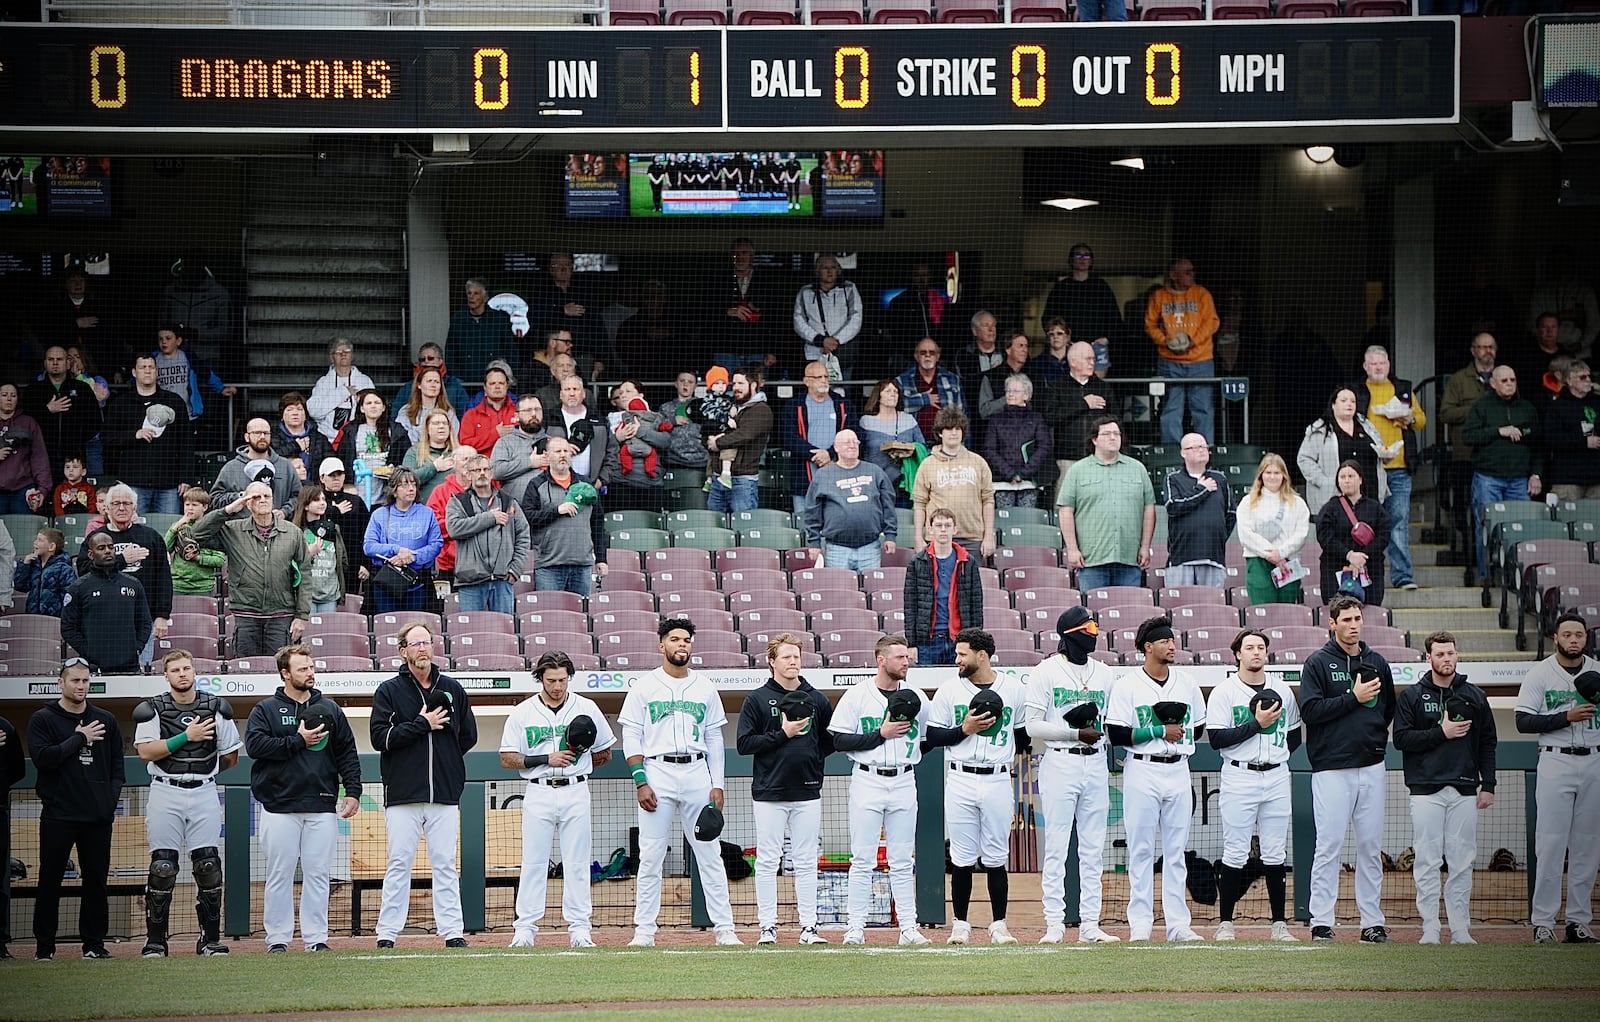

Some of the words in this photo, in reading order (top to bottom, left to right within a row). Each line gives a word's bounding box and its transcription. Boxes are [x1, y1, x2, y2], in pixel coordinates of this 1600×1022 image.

[90, 45, 127, 109] 0
[179, 58, 392, 99] DRAGONS
[473, 48, 509, 110] 0
[548, 60, 598, 98] INN
[689, 51, 700, 106] 1
[750, 58, 822, 98] BALL
[834, 46, 870, 109] 0
[896, 57, 996, 97] STRIKE
[1010, 44, 1047, 108] 0
[1072, 55, 1131, 95] OUT
[1145, 43, 1181, 107] 0
[1219, 54, 1285, 93] MPH
[156, 364, 187, 377] ICTORY
[156, 374, 186, 386] HURCH
[1224, 382, 1246, 394] 112
[226, 680, 255, 693] Ohio
[586, 672, 624, 689] aes
[648, 700, 707, 725] DRAGONS
[1053, 687, 1106, 710] DRAGONS
[905, 742, 915, 759] 7
